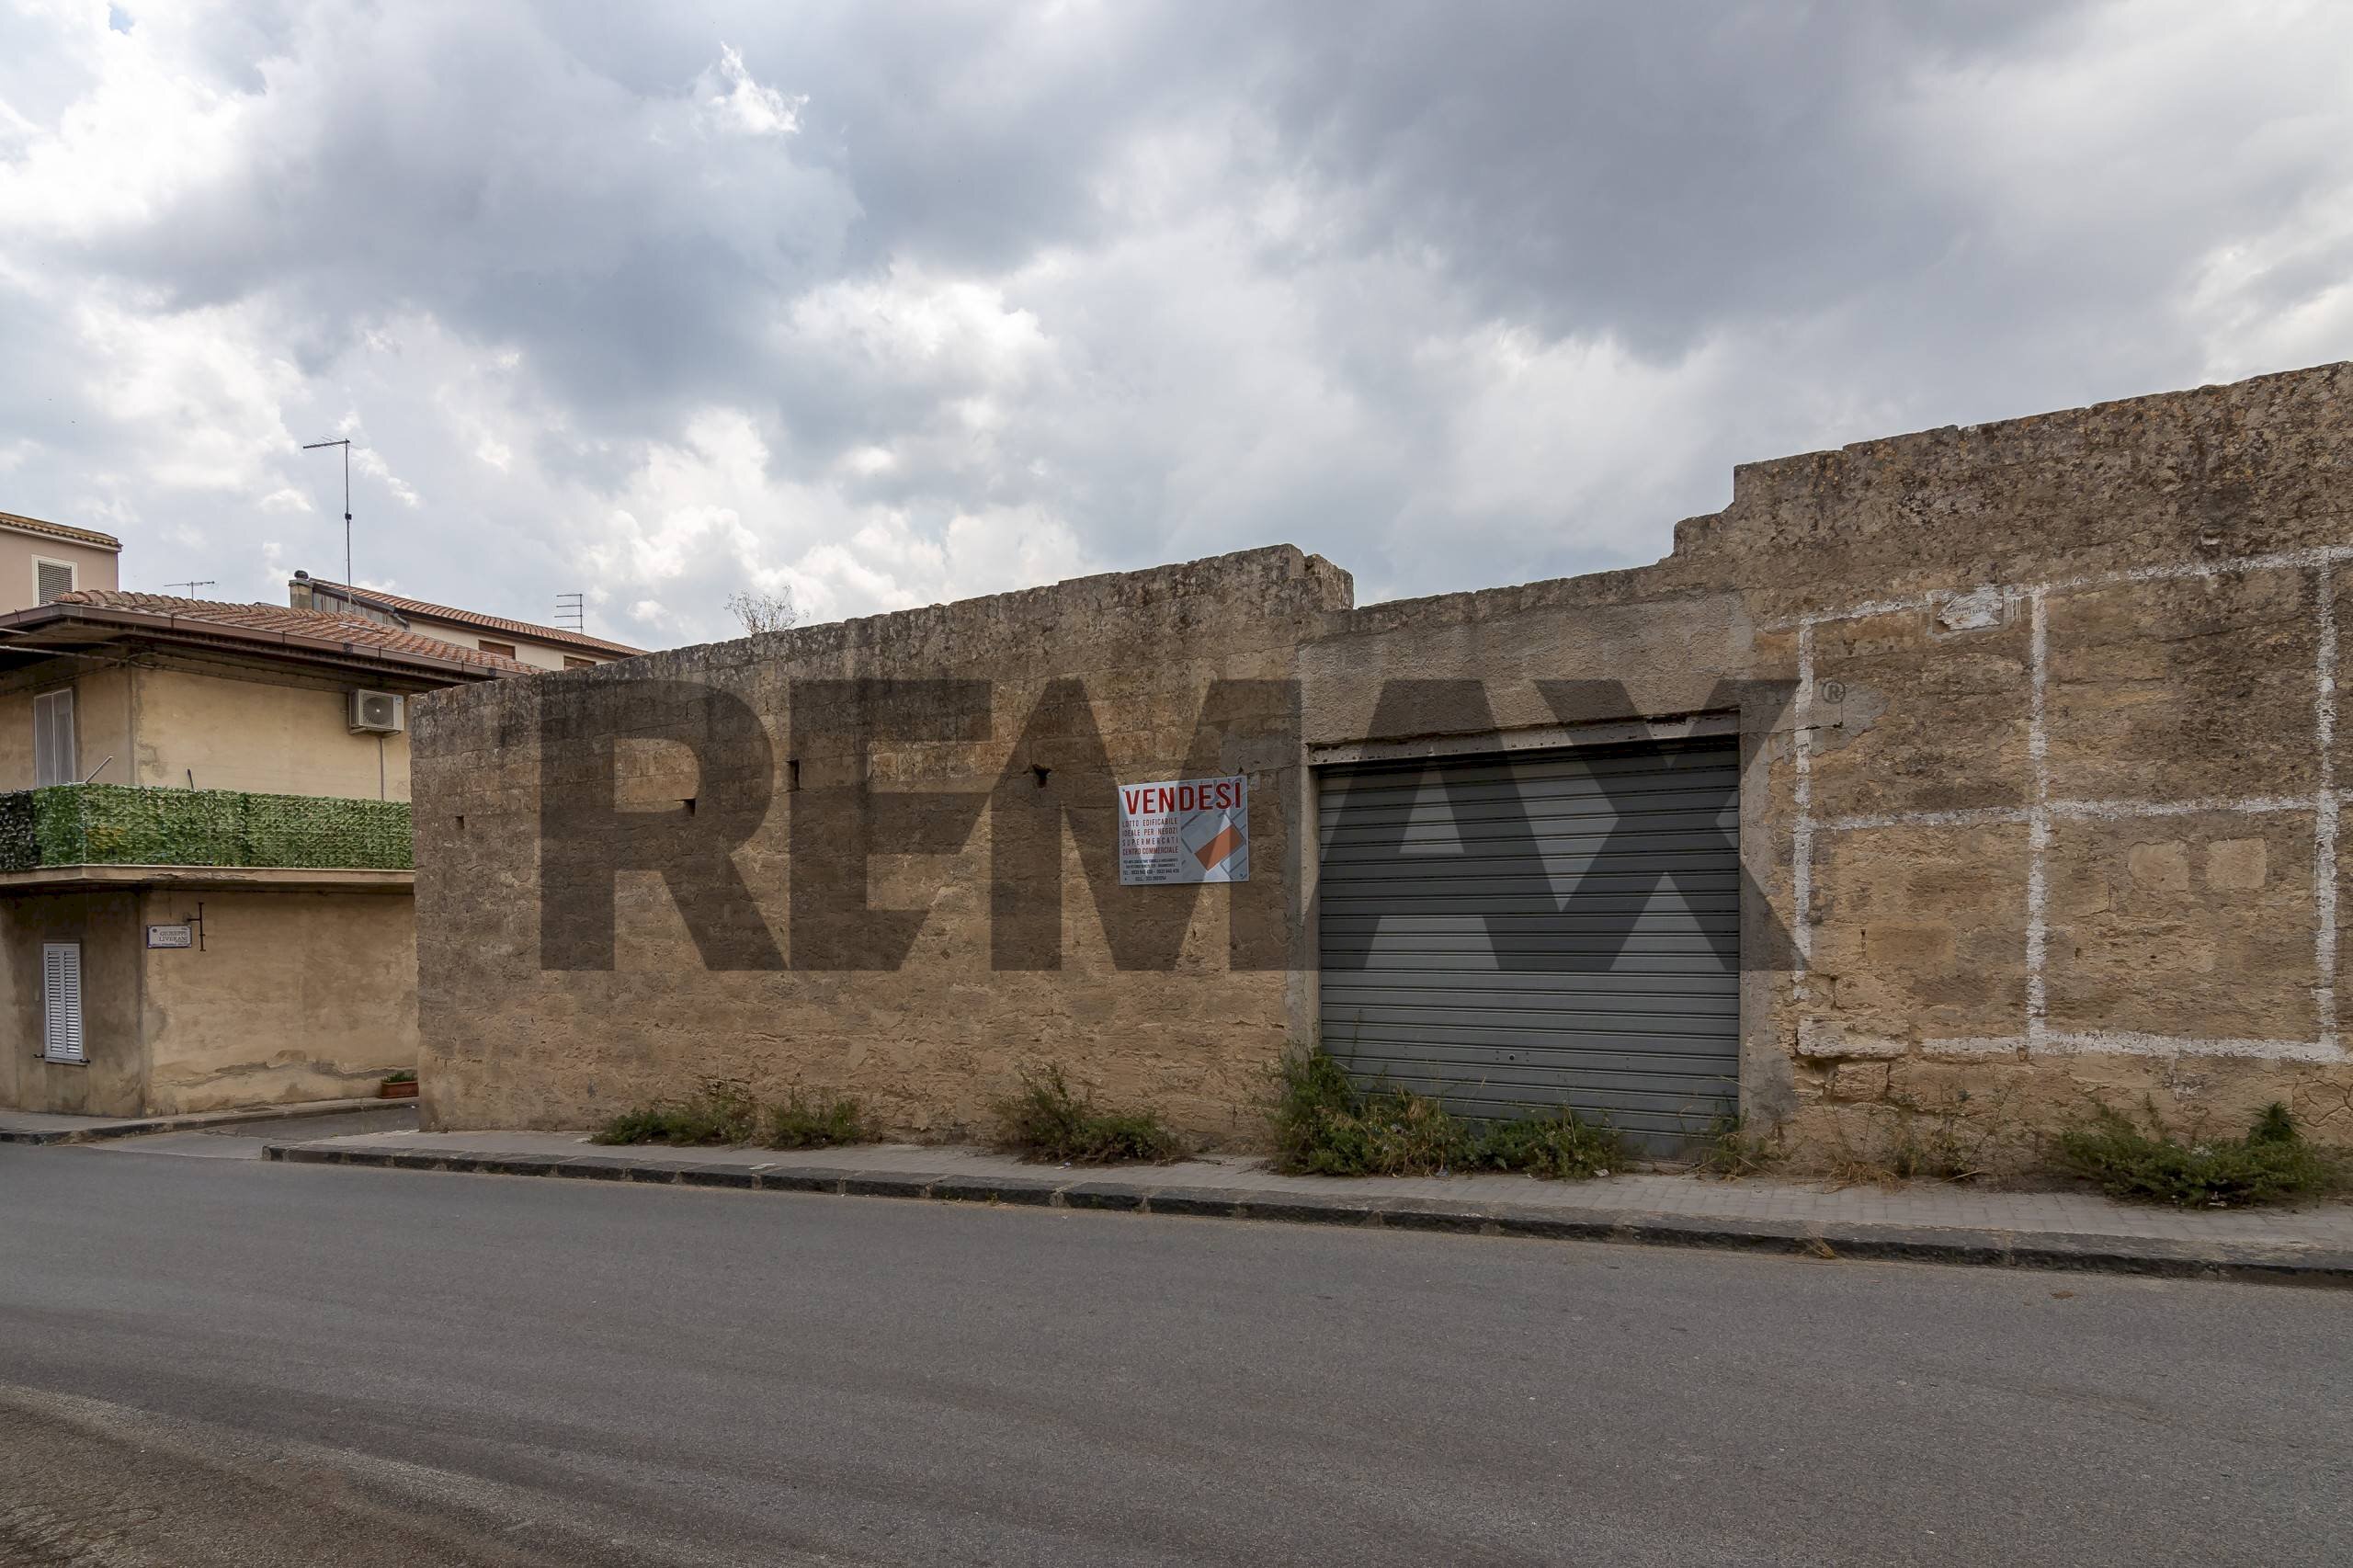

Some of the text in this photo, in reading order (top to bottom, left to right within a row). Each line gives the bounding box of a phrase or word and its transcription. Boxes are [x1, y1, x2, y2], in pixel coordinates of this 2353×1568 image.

[1125, 782, 1241, 815] VENDESI
[1142, 817, 1177, 826] EDIFICABILE
[1122, 829, 1141, 837] IDEALE
[1122, 836, 1178, 846] SUPERMERCATI
[1142, 846, 1178, 855] COMMERCIALE
